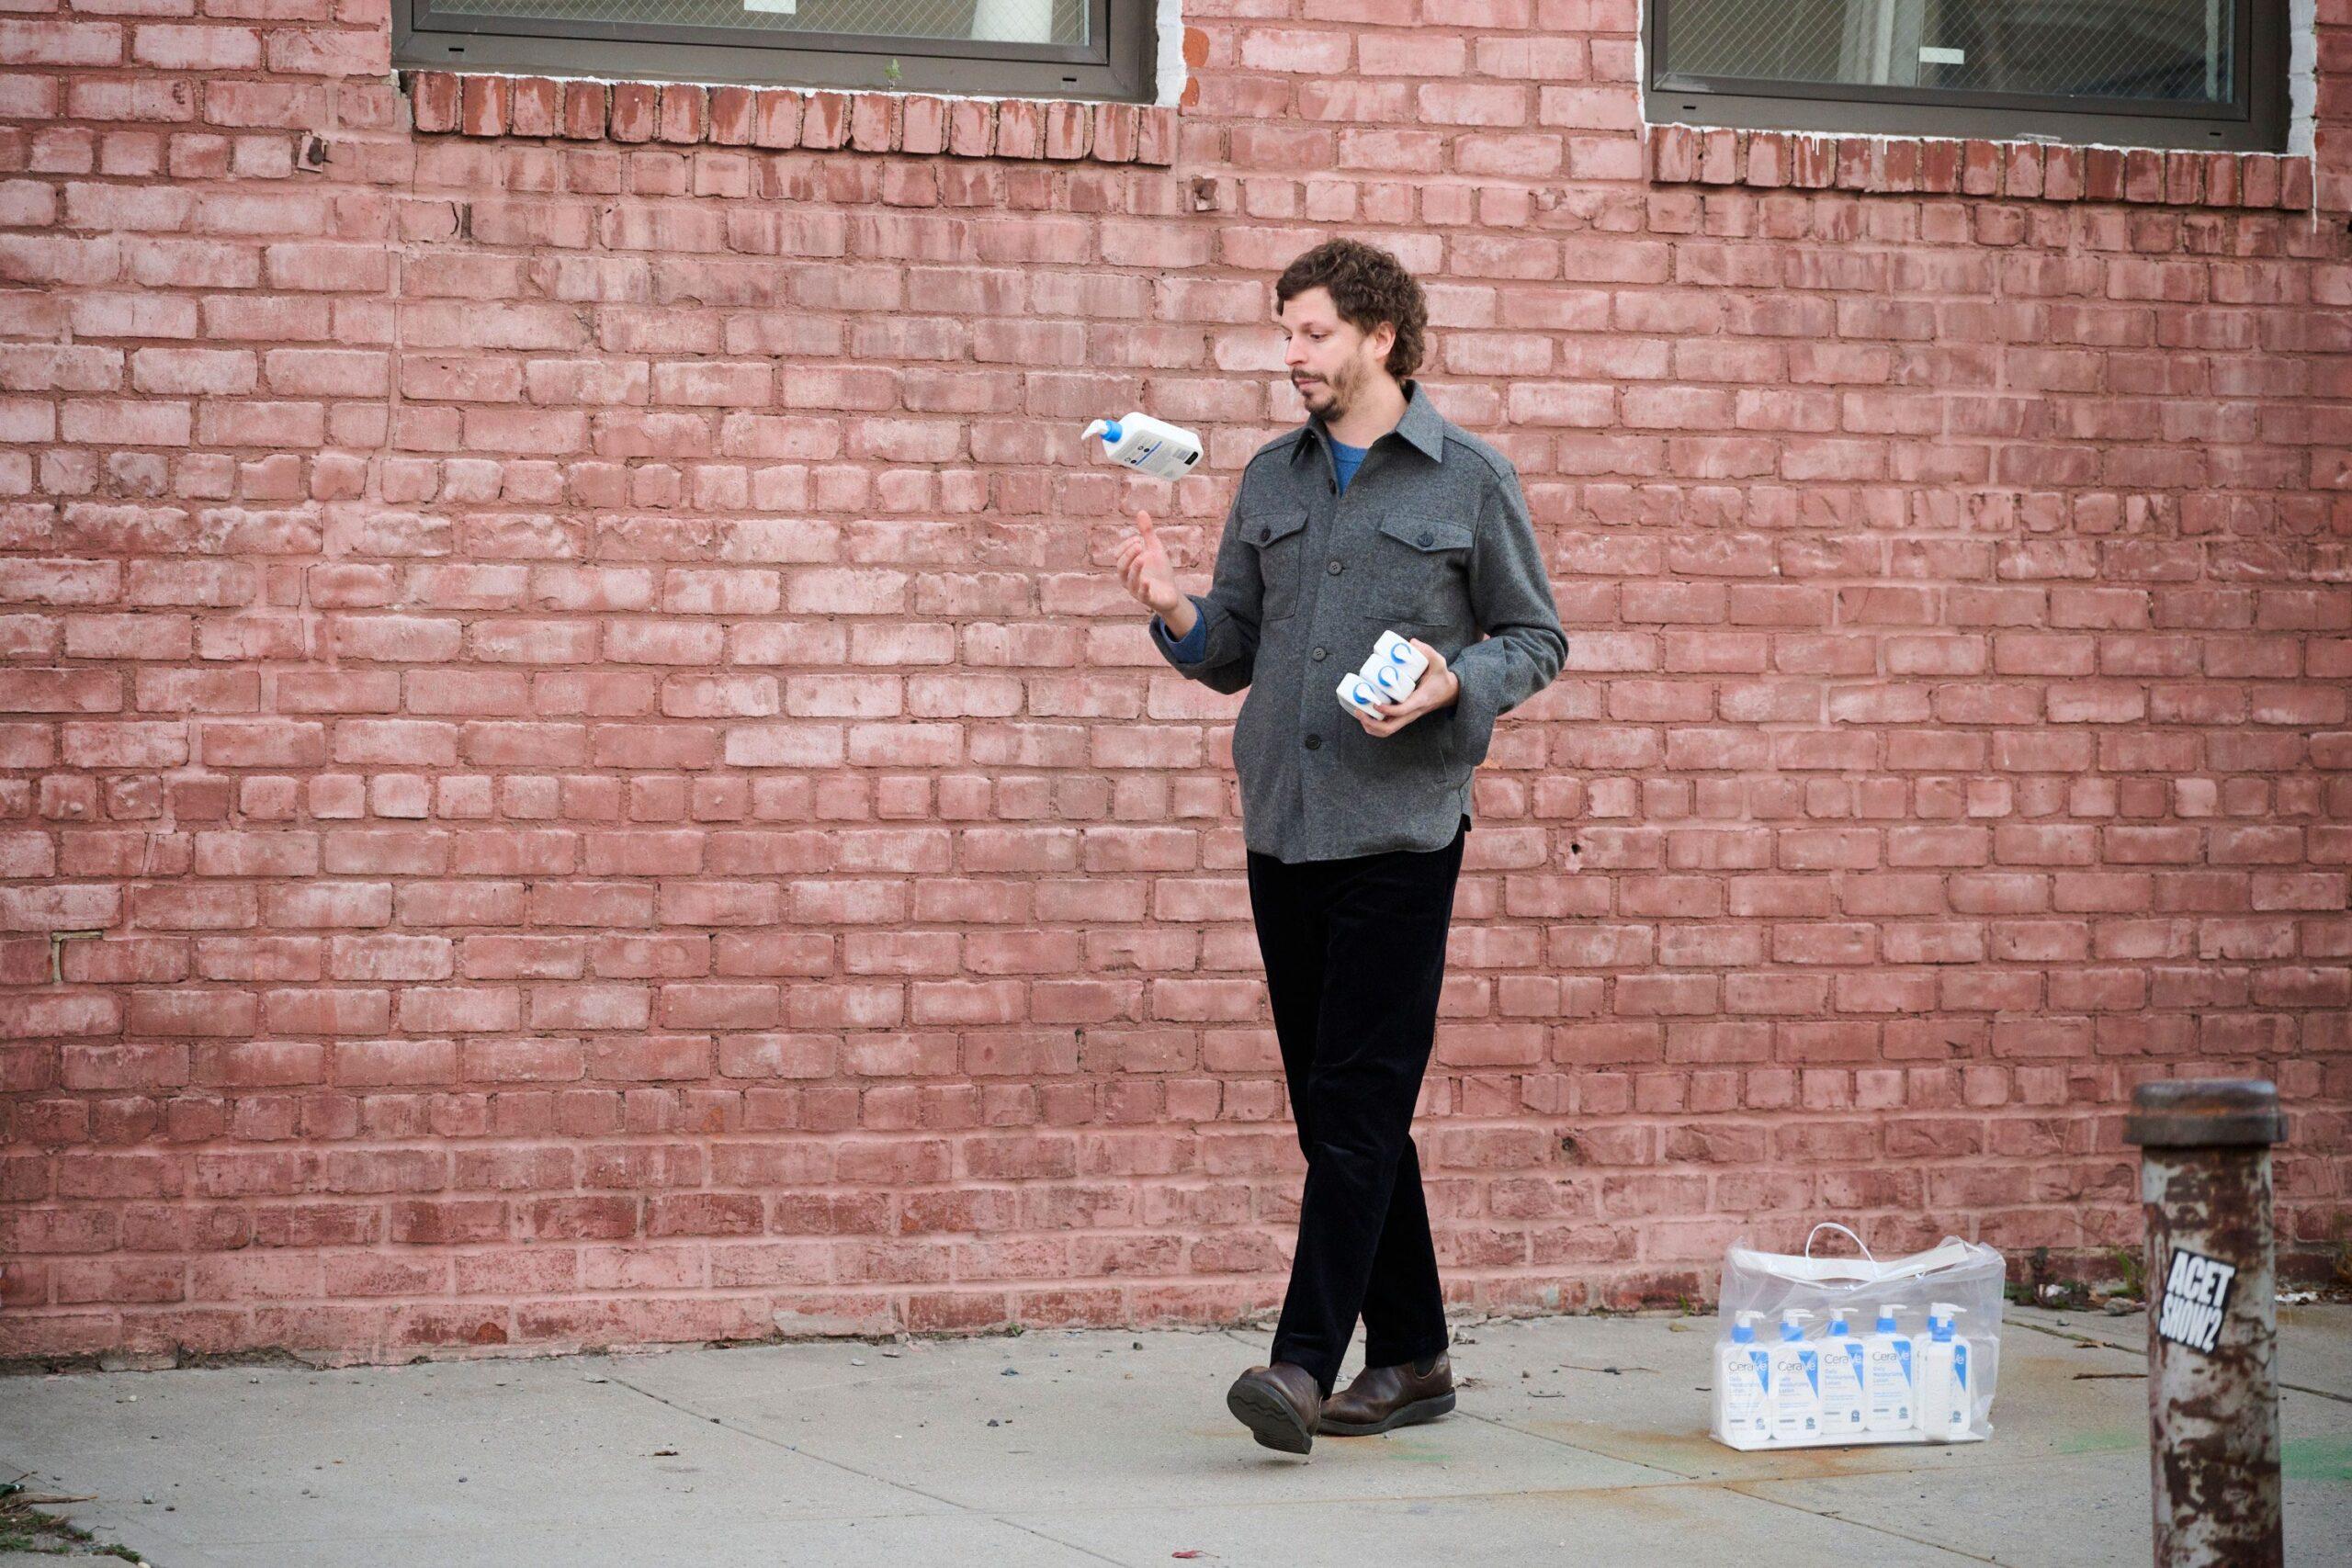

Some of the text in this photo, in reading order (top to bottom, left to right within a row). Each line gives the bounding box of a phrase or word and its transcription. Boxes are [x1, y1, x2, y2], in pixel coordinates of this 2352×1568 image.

[2166, 1250, 2235, 1308] ACET
[1825, 1354, 1861, 1365] CeraVe
[1872, 1350, 1909, 1361] CeraVe
